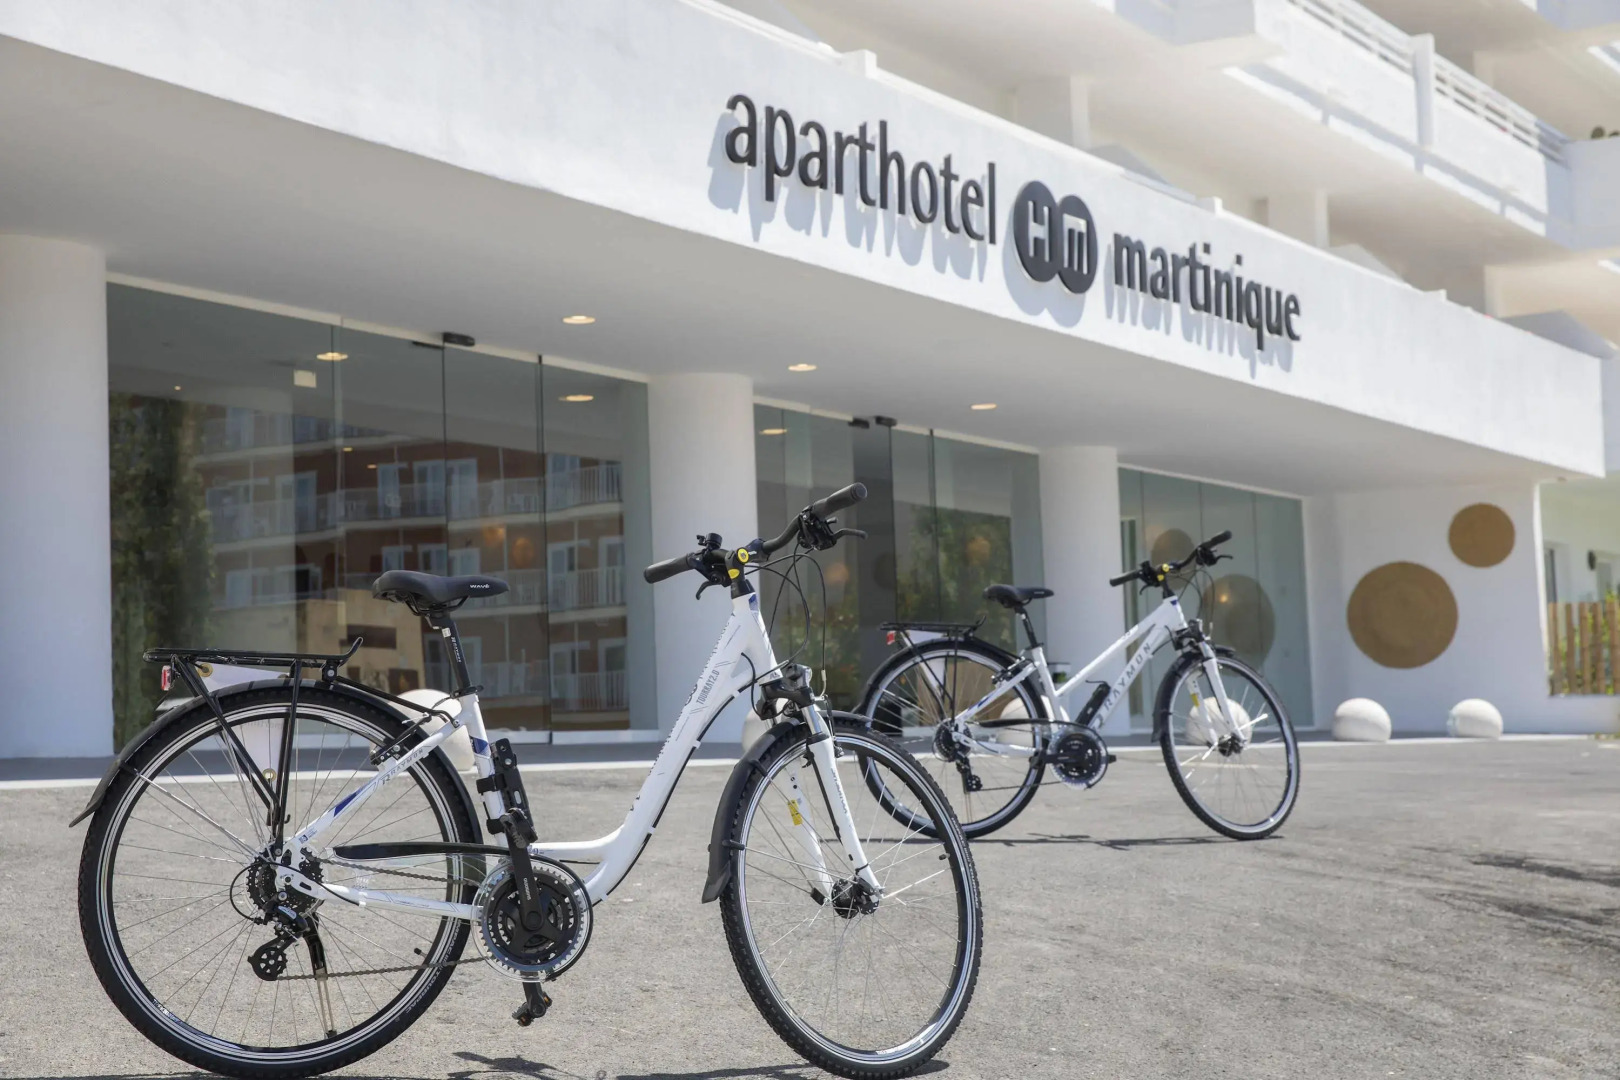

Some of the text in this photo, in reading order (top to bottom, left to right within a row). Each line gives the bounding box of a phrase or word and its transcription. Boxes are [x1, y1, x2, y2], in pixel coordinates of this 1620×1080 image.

[725, 95, 996, 245] aparthotel
[1114, 231, 1301, 350] martinique
[1103, 642, 1151, 711] RAYMON
